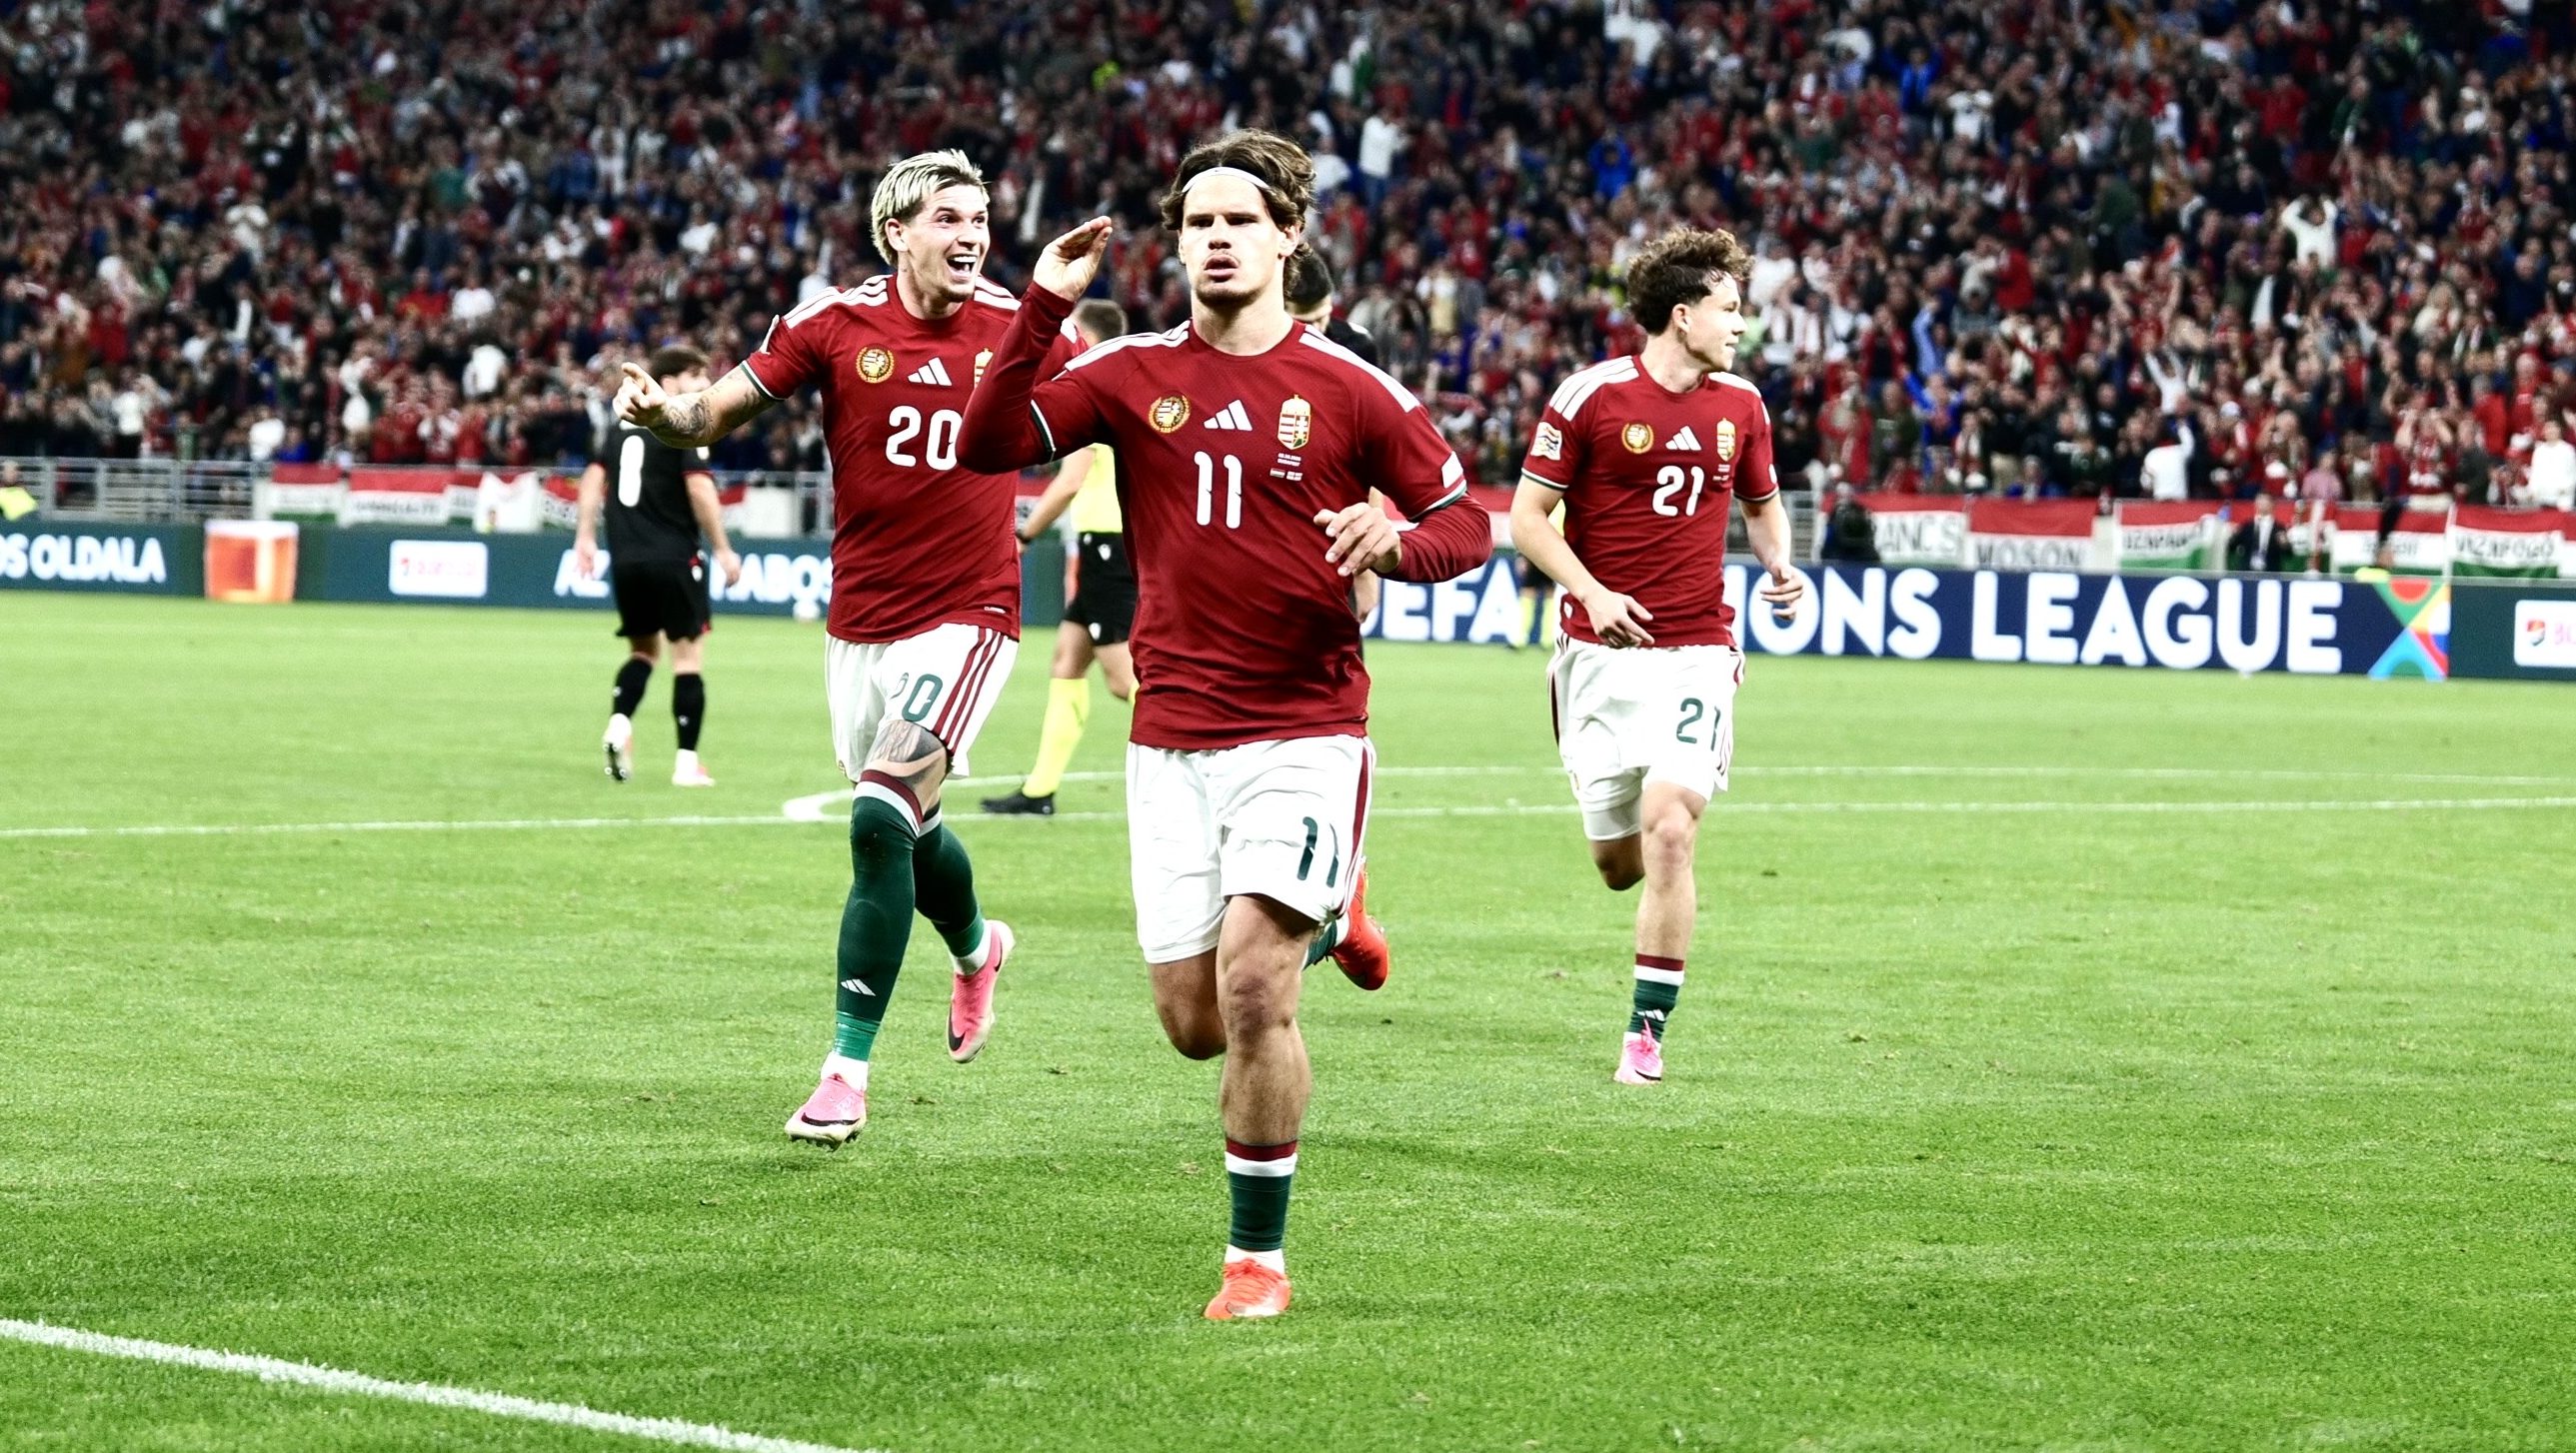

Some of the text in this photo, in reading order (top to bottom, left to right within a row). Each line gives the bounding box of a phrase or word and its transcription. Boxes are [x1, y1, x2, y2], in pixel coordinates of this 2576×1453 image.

[885, 405, 963, 471] 20
[1194, 451, 1243, 529] 11
[1652, 465, 1704, 517] 21
[29, 534, 167, 584] OLDALA
[1359, 556, 2343, 675] EFA IONS LEAGUE
[1676, 698, 1721, 751] 21
[1296, 815, 1339, 888] 11
